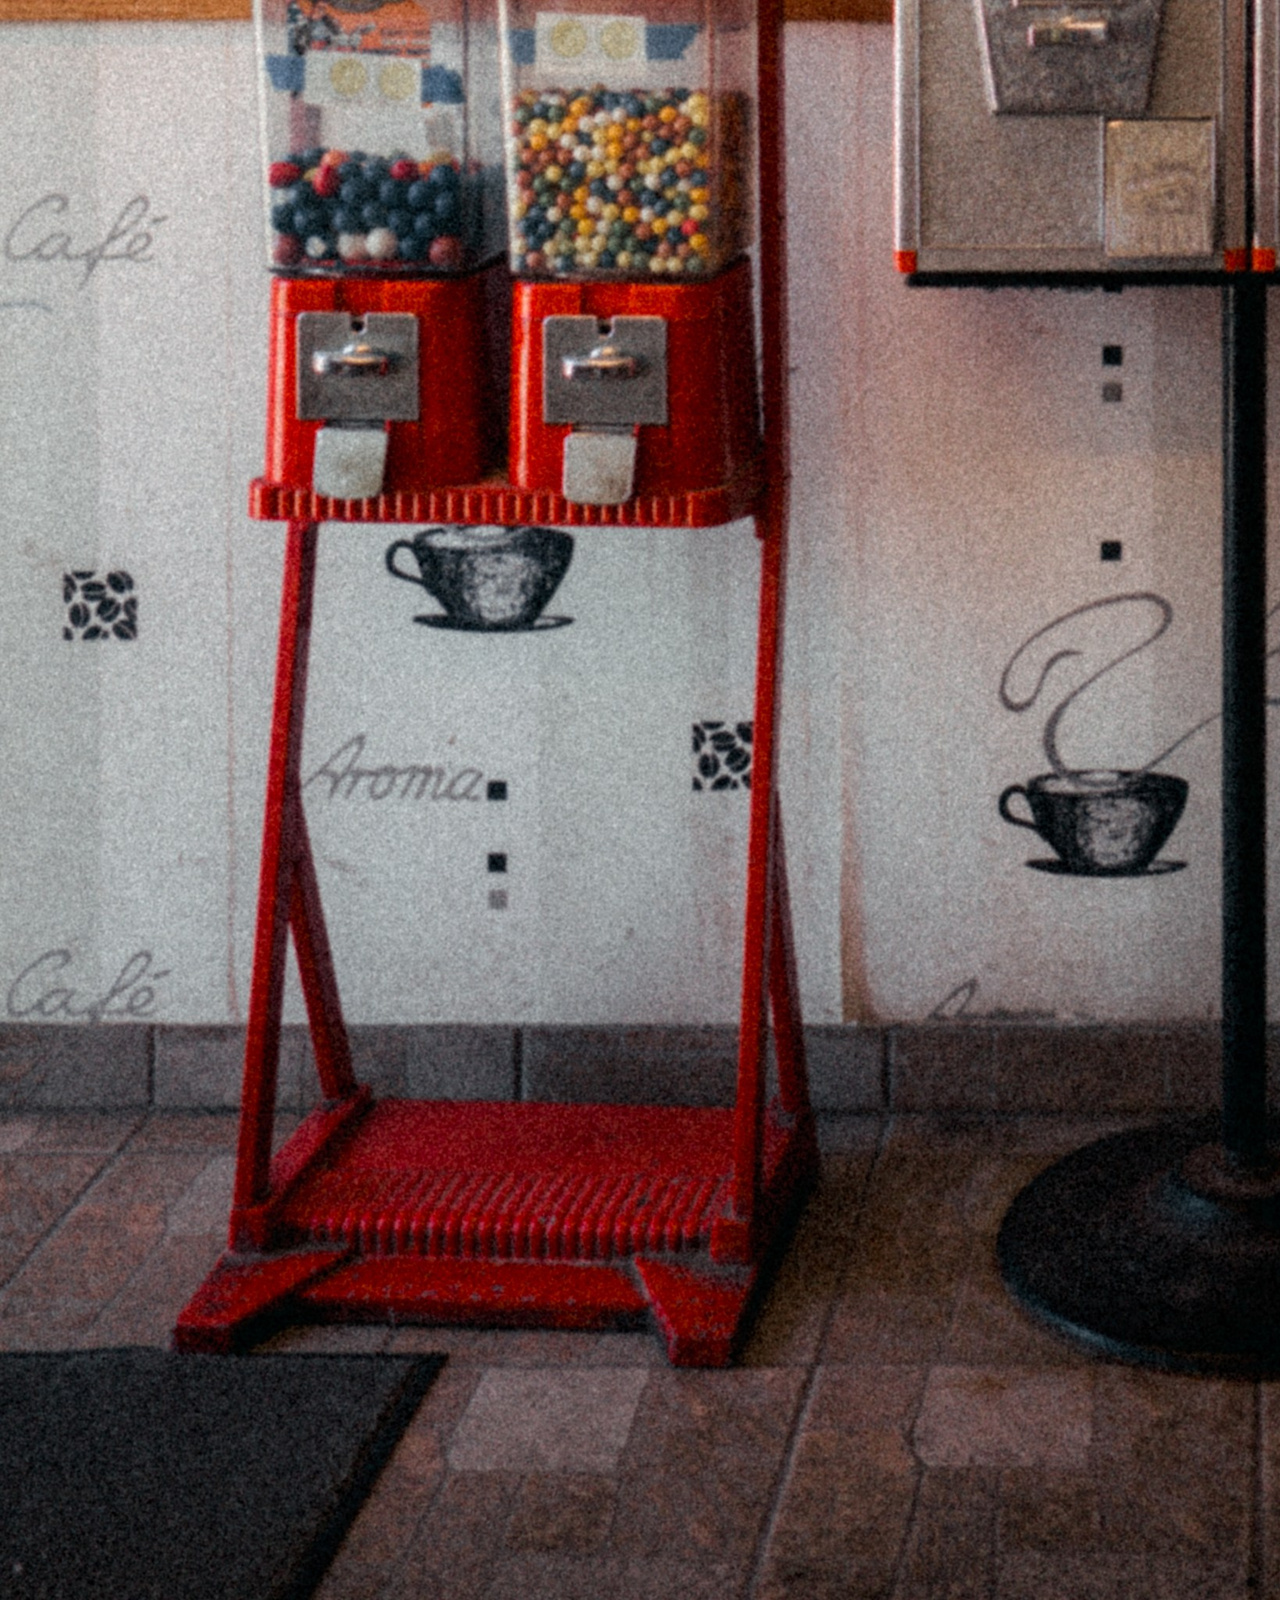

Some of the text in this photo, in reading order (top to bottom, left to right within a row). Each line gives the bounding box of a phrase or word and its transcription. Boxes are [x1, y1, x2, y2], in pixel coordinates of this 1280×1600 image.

[6, 193, 169, 290] Café
[302, 734, 483, 801] Aroma
[7, 949, 172, 1025] Café
